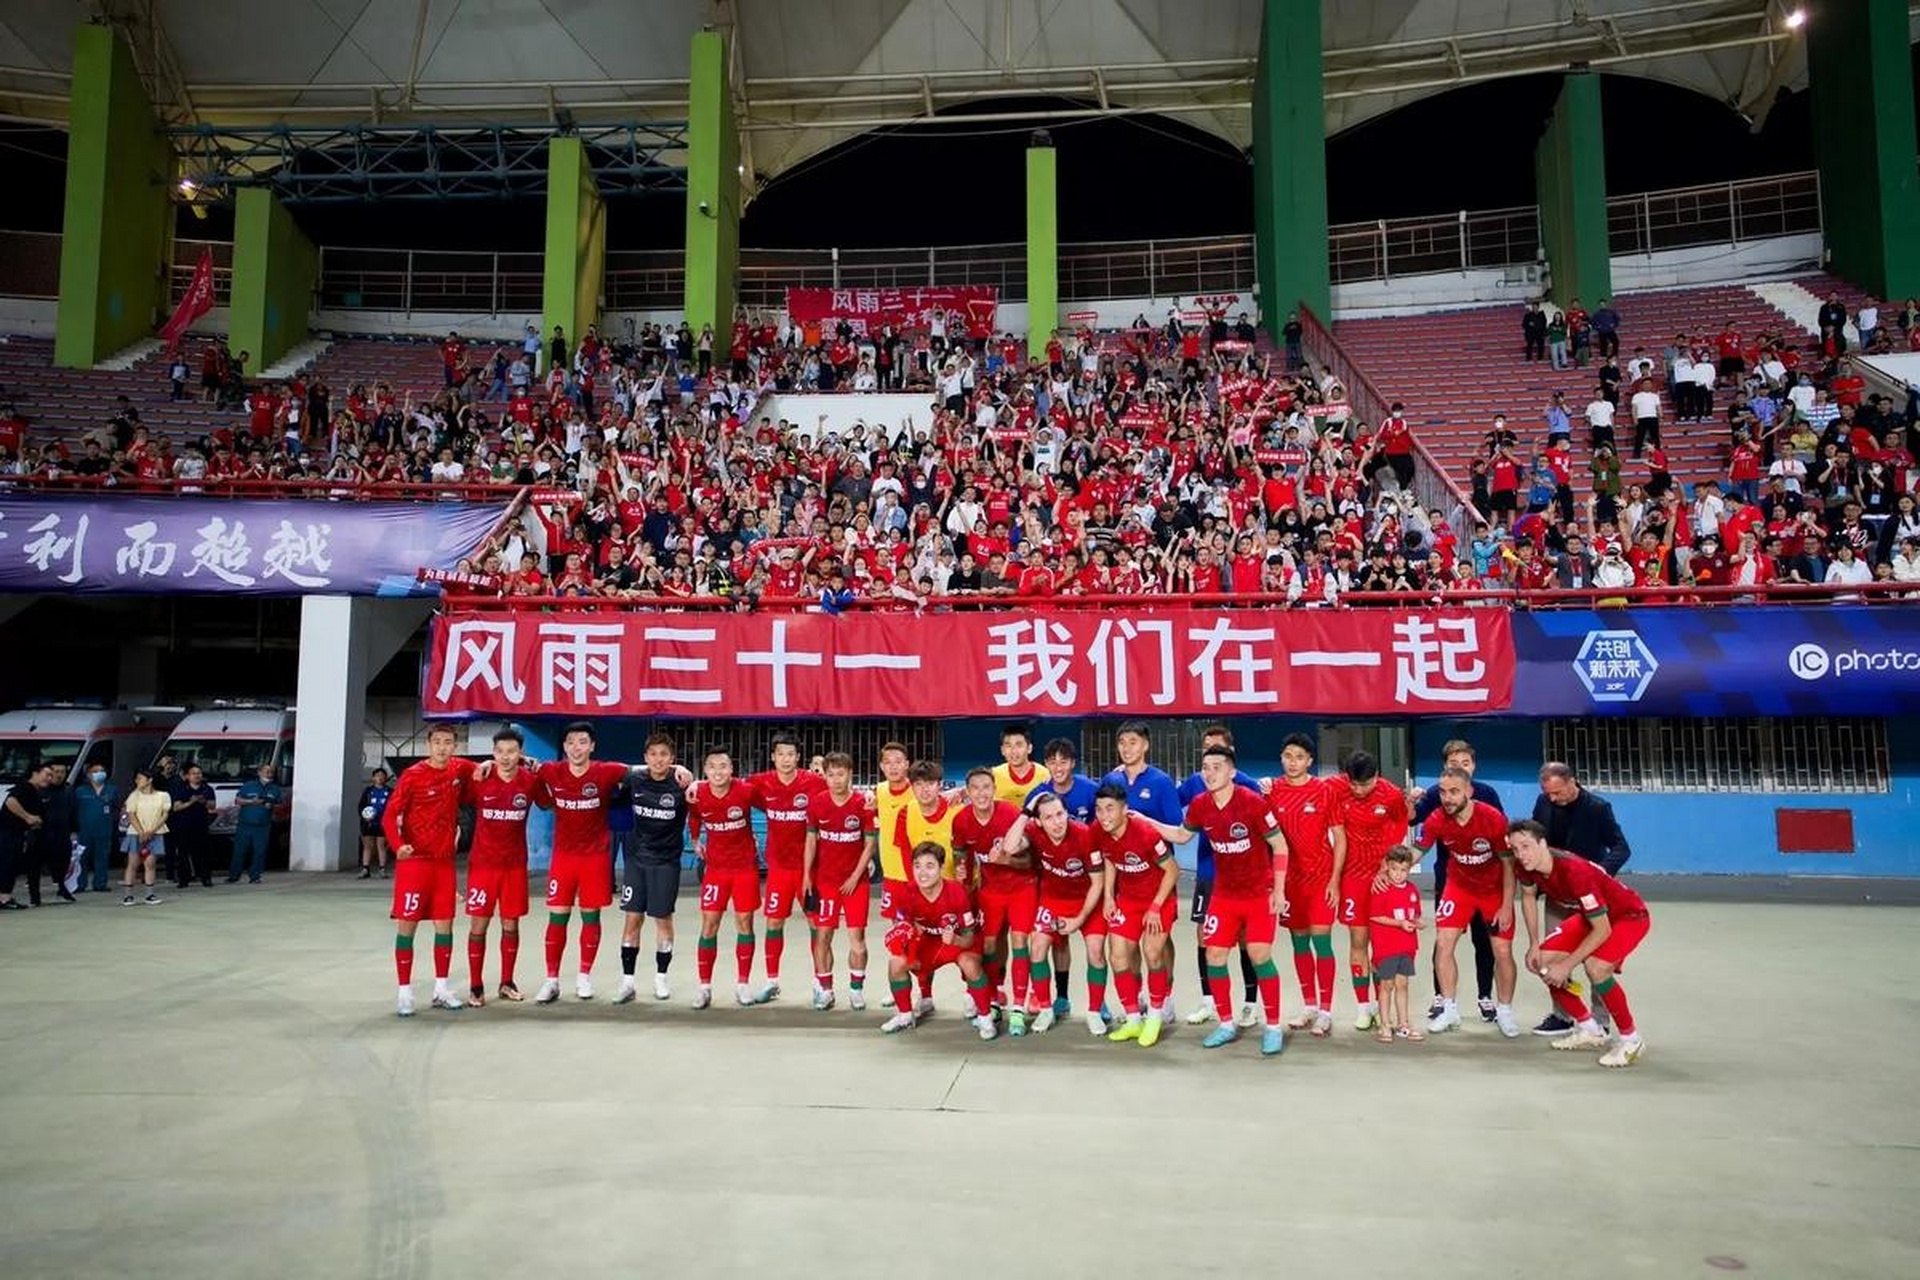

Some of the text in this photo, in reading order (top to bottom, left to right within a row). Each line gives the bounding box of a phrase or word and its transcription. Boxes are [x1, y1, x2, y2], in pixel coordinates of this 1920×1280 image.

[832, 288, 956, 313] 风雨三十一
[0, 512, 331, 587] 利而超越
[1595, 640, 1631, 658] 共创
[436, 615, 1490, 708] 风雨三十一 我们在一起
[1589, 660, 1641, 678] 新未来
[549, 879, 558, 896] 9
[703, 884, 719, 902] 21
[404, 893, 420, 911] 15
[468, 888, 487, 906] 24
[769, 892, 779, 908] 5
[819, 899, 834, 916] 11
[1036, 906, 1051, 924] 16
[1344, 898, 1355, 916] 2
[1436, 900, 1455, 916] 20
[1203, 914, 1218, 934] 29
